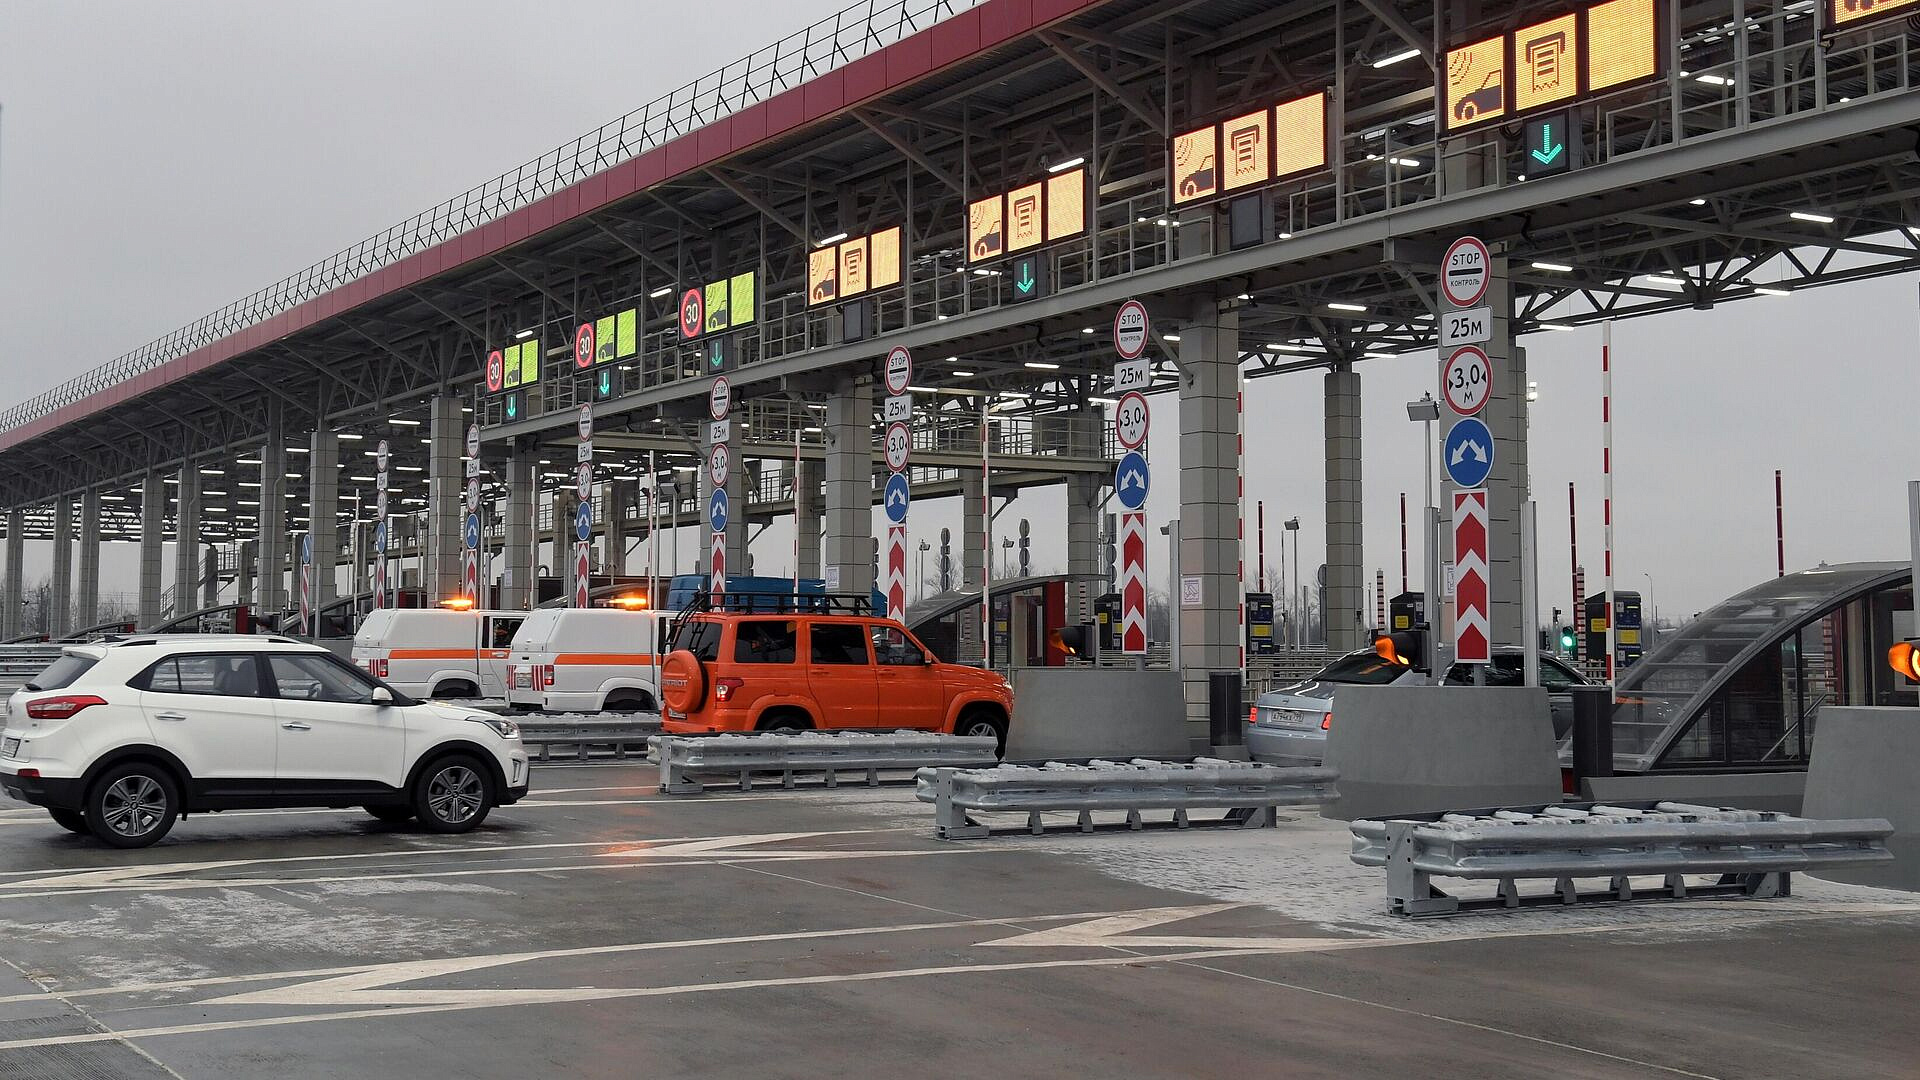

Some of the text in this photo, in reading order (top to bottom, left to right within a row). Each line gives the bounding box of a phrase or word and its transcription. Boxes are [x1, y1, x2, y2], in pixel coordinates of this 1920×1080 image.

[1452, 253, 1480, 266] STOP
[685, 302, 698, 324] 30
[1121, 314, 1142, 325] STOP
[579, 336, 590, 355] 30
[890, 356, 906, 367] STOP
[490, 362, 500, 380] 30
[1454, 364, 1480, 388] 3,0
[1123, 407, 1141, 427] 3,0
[890, 436, 905, 453] 3,0
